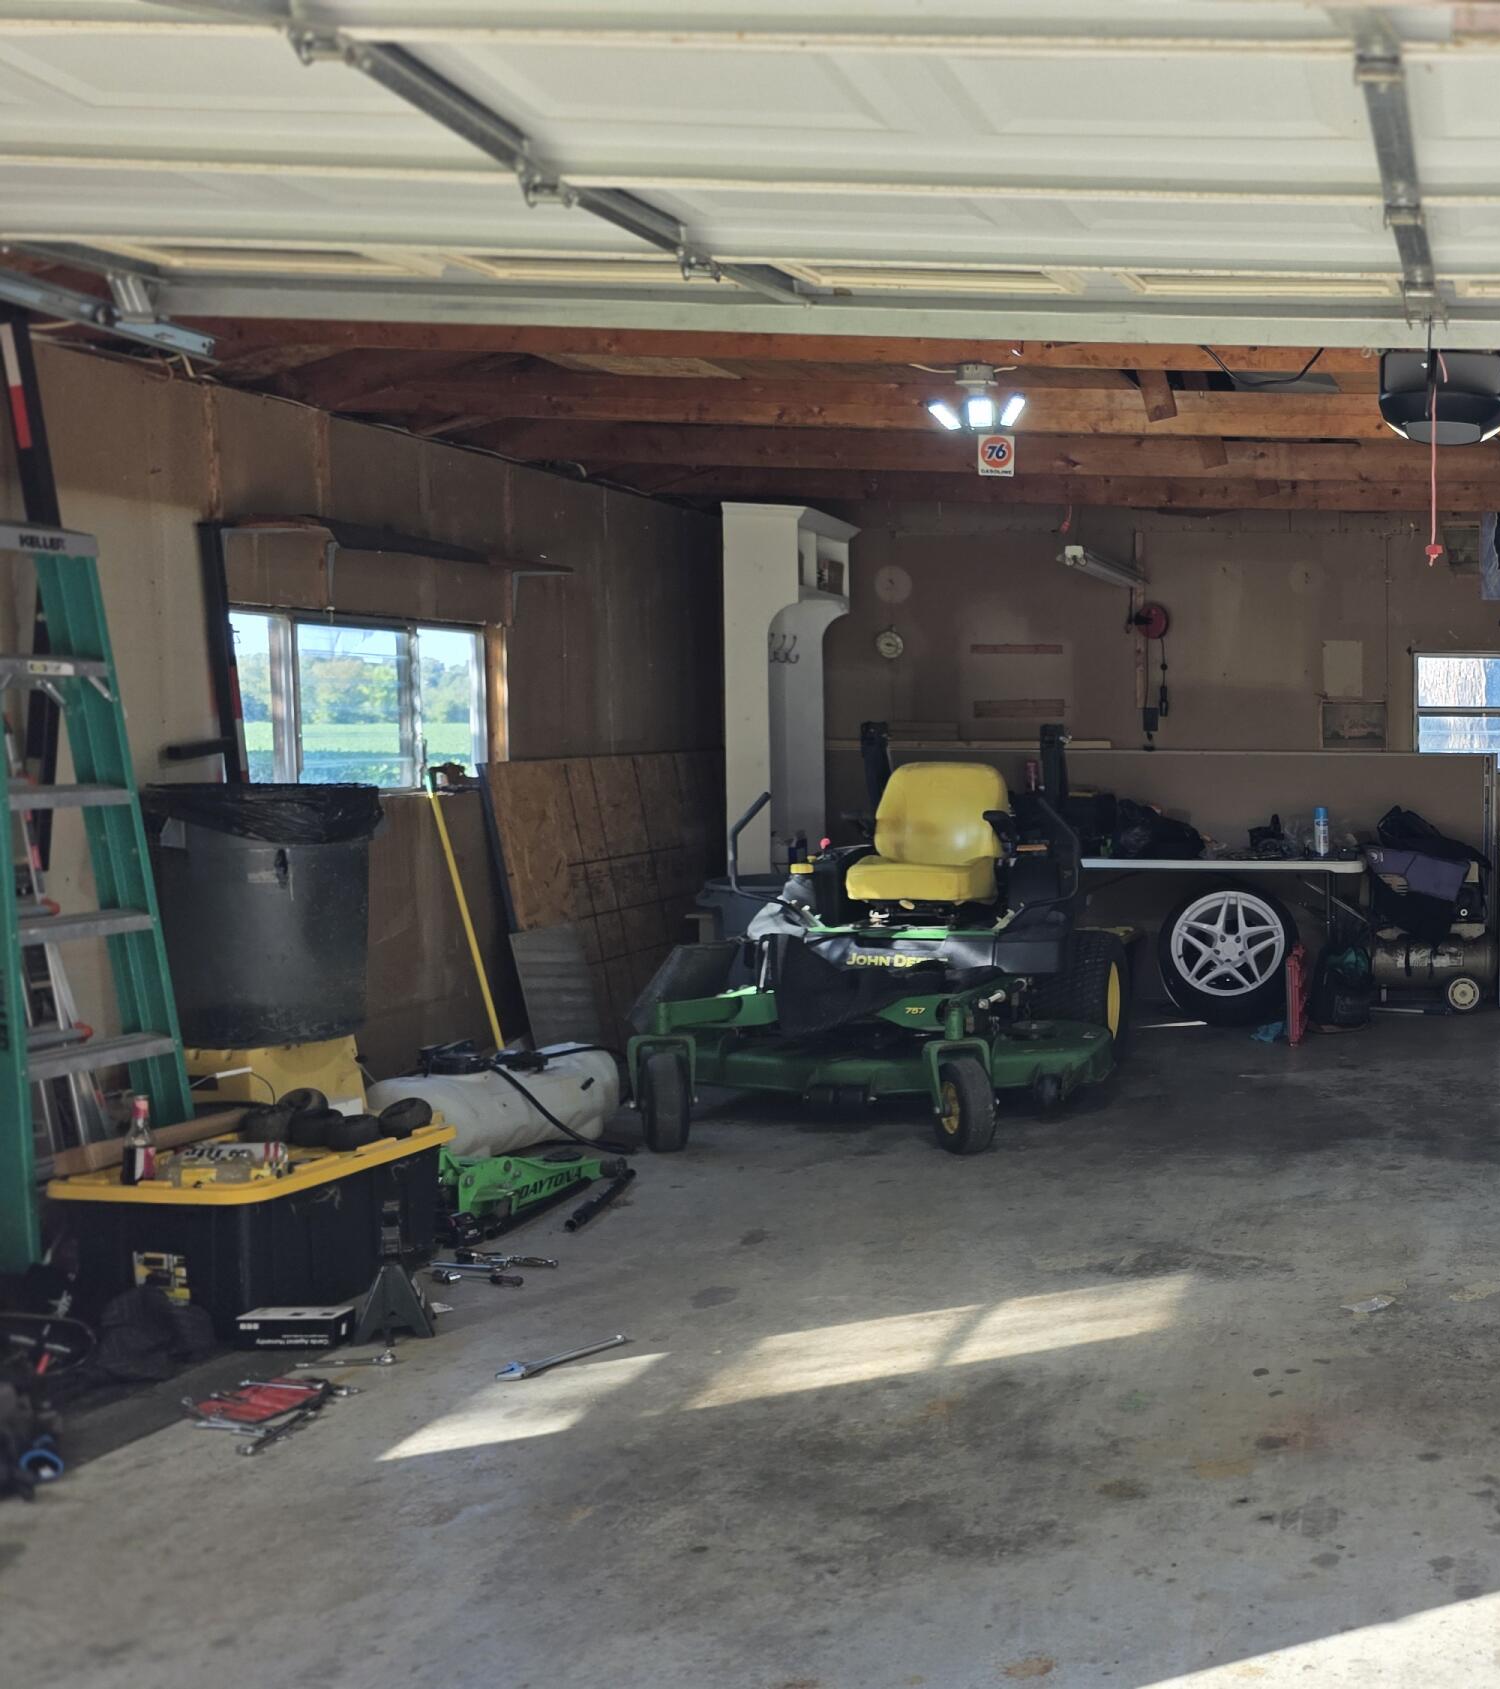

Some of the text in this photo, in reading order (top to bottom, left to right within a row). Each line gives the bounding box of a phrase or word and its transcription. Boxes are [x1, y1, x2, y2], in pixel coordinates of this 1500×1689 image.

[987, 443, 1007, 460] 76
[19, 534, 66, 551] KELLER
[846, 952, 890, 967] JOHN
